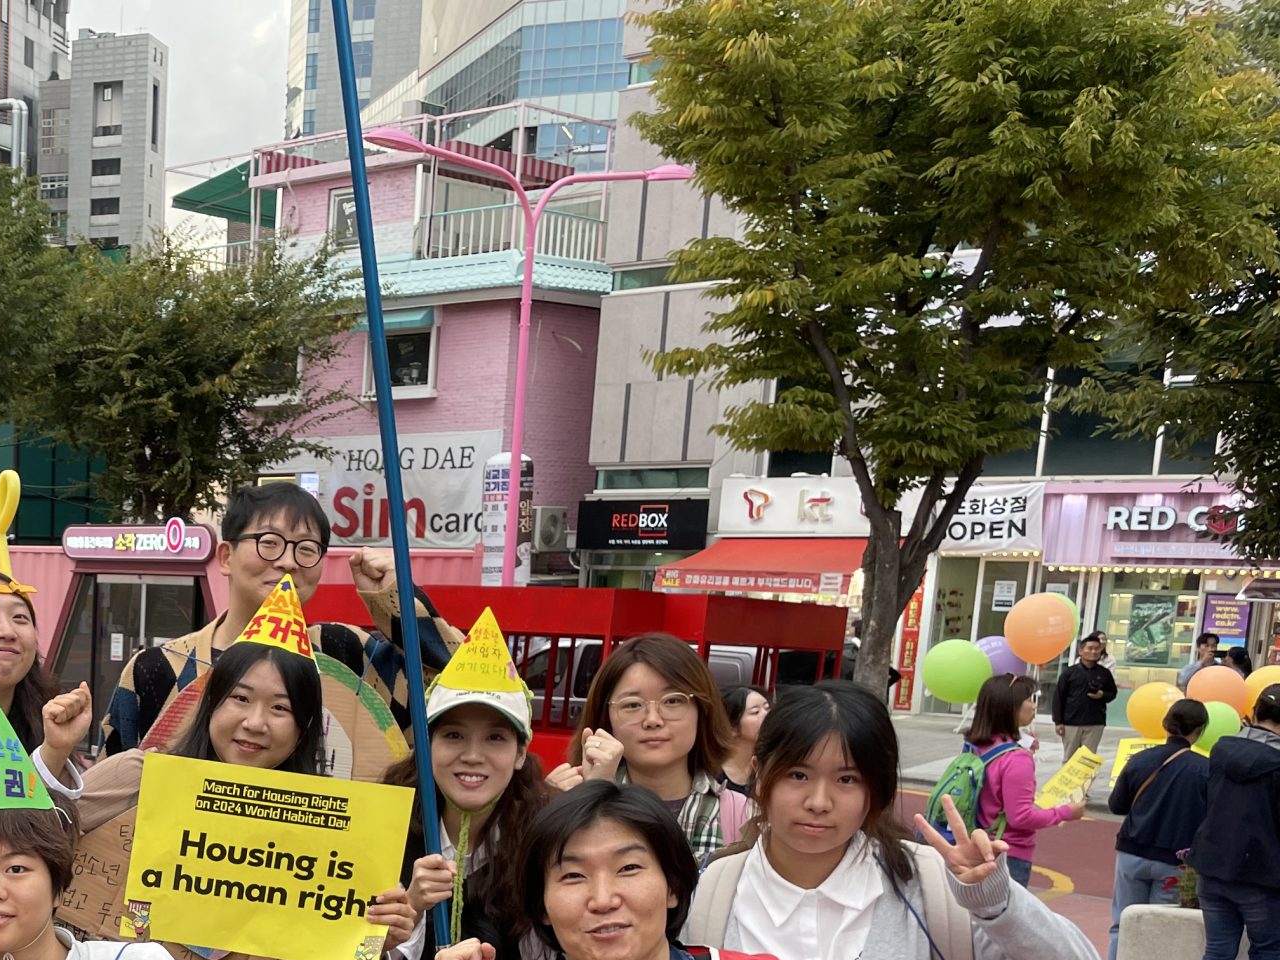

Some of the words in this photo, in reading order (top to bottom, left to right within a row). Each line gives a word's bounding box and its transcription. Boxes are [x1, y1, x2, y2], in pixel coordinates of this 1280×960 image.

[346, 447, 415, 472] HOG
[422, 445, 476, 471] DAE
[948, 518, 1027, 541] OPEN
[1107, 505, 1177, 531] RED
[243, 615, 312, 658] 주거권
[202, 780, 239, 798] March
[241, 784, 260, 800] for
[261, 788, 309, 809] Housing
[310, 793, 349, 813] Rights
[195, 797, 210, 811] on
[212, 798, 243, 814] 2024
[245, 802, 281, 820] World
[282, 807, 325, 826] Habitat
[325, 812, 351, 831] Day
[179, 829, 318, 879] Housing
[327, 850, 354, 880] is
[141, 869, 162, 889] a
[172, 864, 288, 906] human
